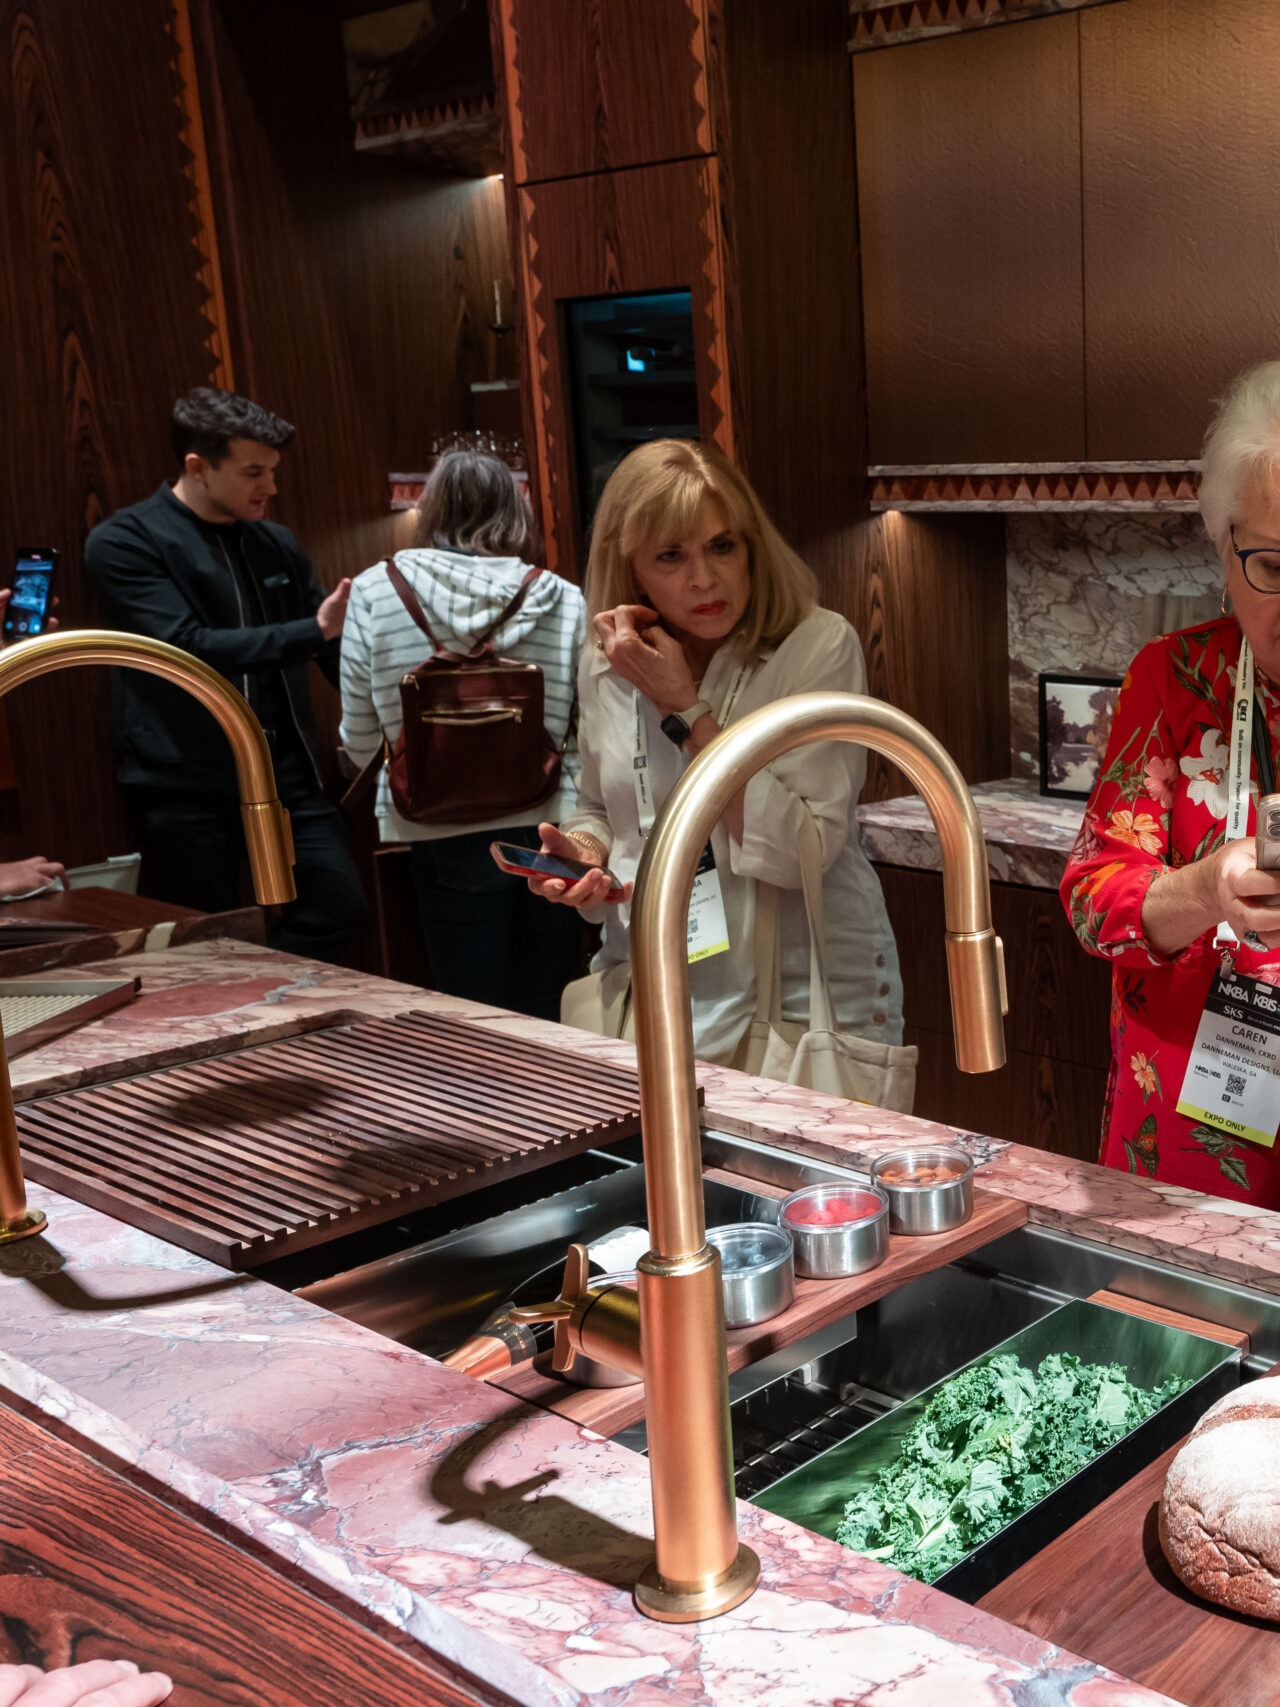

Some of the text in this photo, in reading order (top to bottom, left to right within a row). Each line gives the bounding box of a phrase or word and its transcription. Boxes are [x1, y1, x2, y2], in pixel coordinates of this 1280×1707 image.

[1217, 981, 1249, 1003] NKBA
[1252, 993, 1278, 1012] KBIS
[1223, 1005, 1244, 1019] SKS
[1232, 1025, 1268, 1045] CAREN
[1201, 1042, 1240, 1061] DANNEMAN
[1216, 1034, 1277, 1061] DANNEMAN, CKBD
[1204, 1111, 1246, 1133] EXPO ONLY
